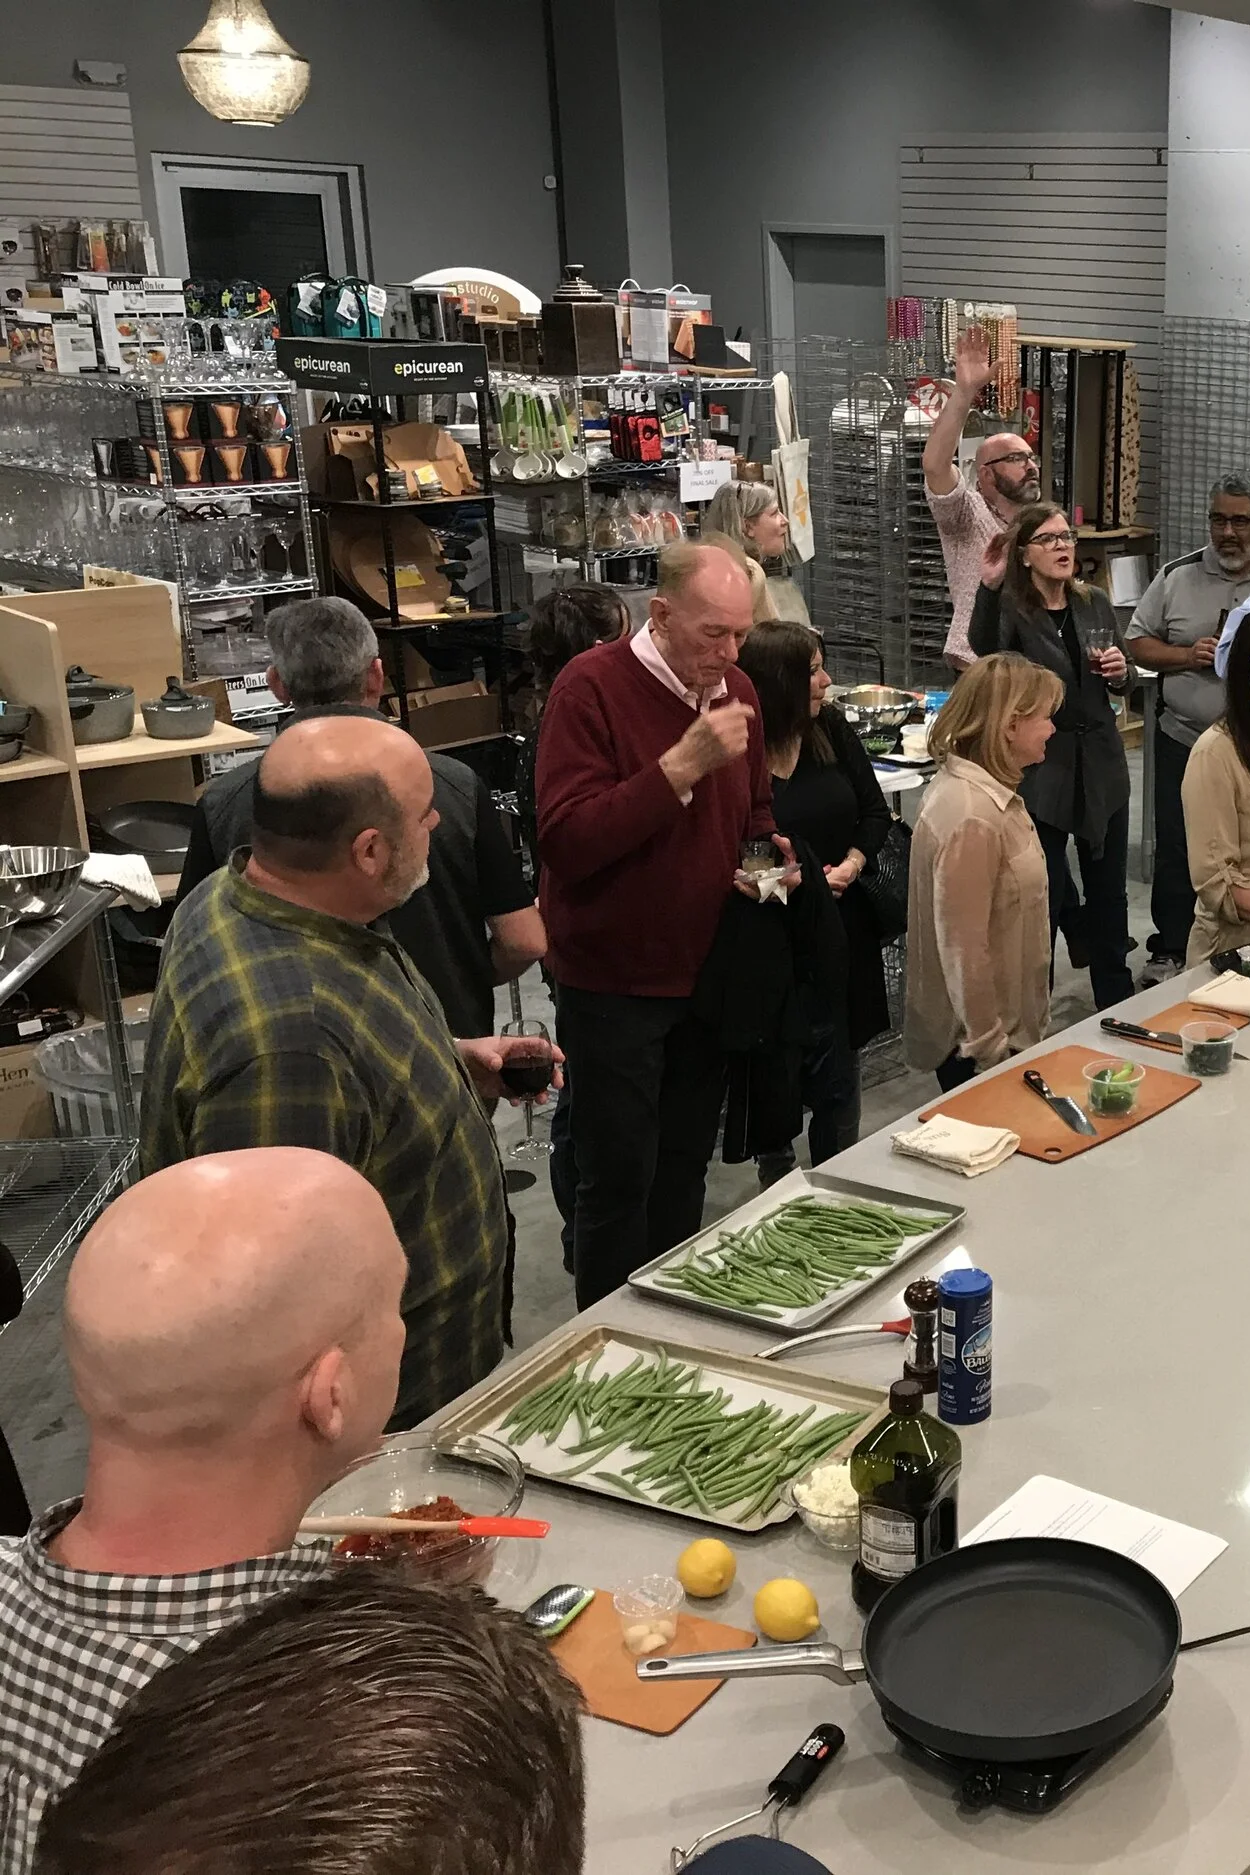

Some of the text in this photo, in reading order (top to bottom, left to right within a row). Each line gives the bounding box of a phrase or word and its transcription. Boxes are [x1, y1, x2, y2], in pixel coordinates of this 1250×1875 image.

[108, 280, 124, 290] Cold
[125, 281, 143, 290] Bowl
[154, 282, 164, 290] Ice
[457, 281, 499, 304] studio
[294, 355, 351, 373] epicurean
[394, 359, 464, 377] epicurean
[225, 675, 267, 691] izers On Ic
